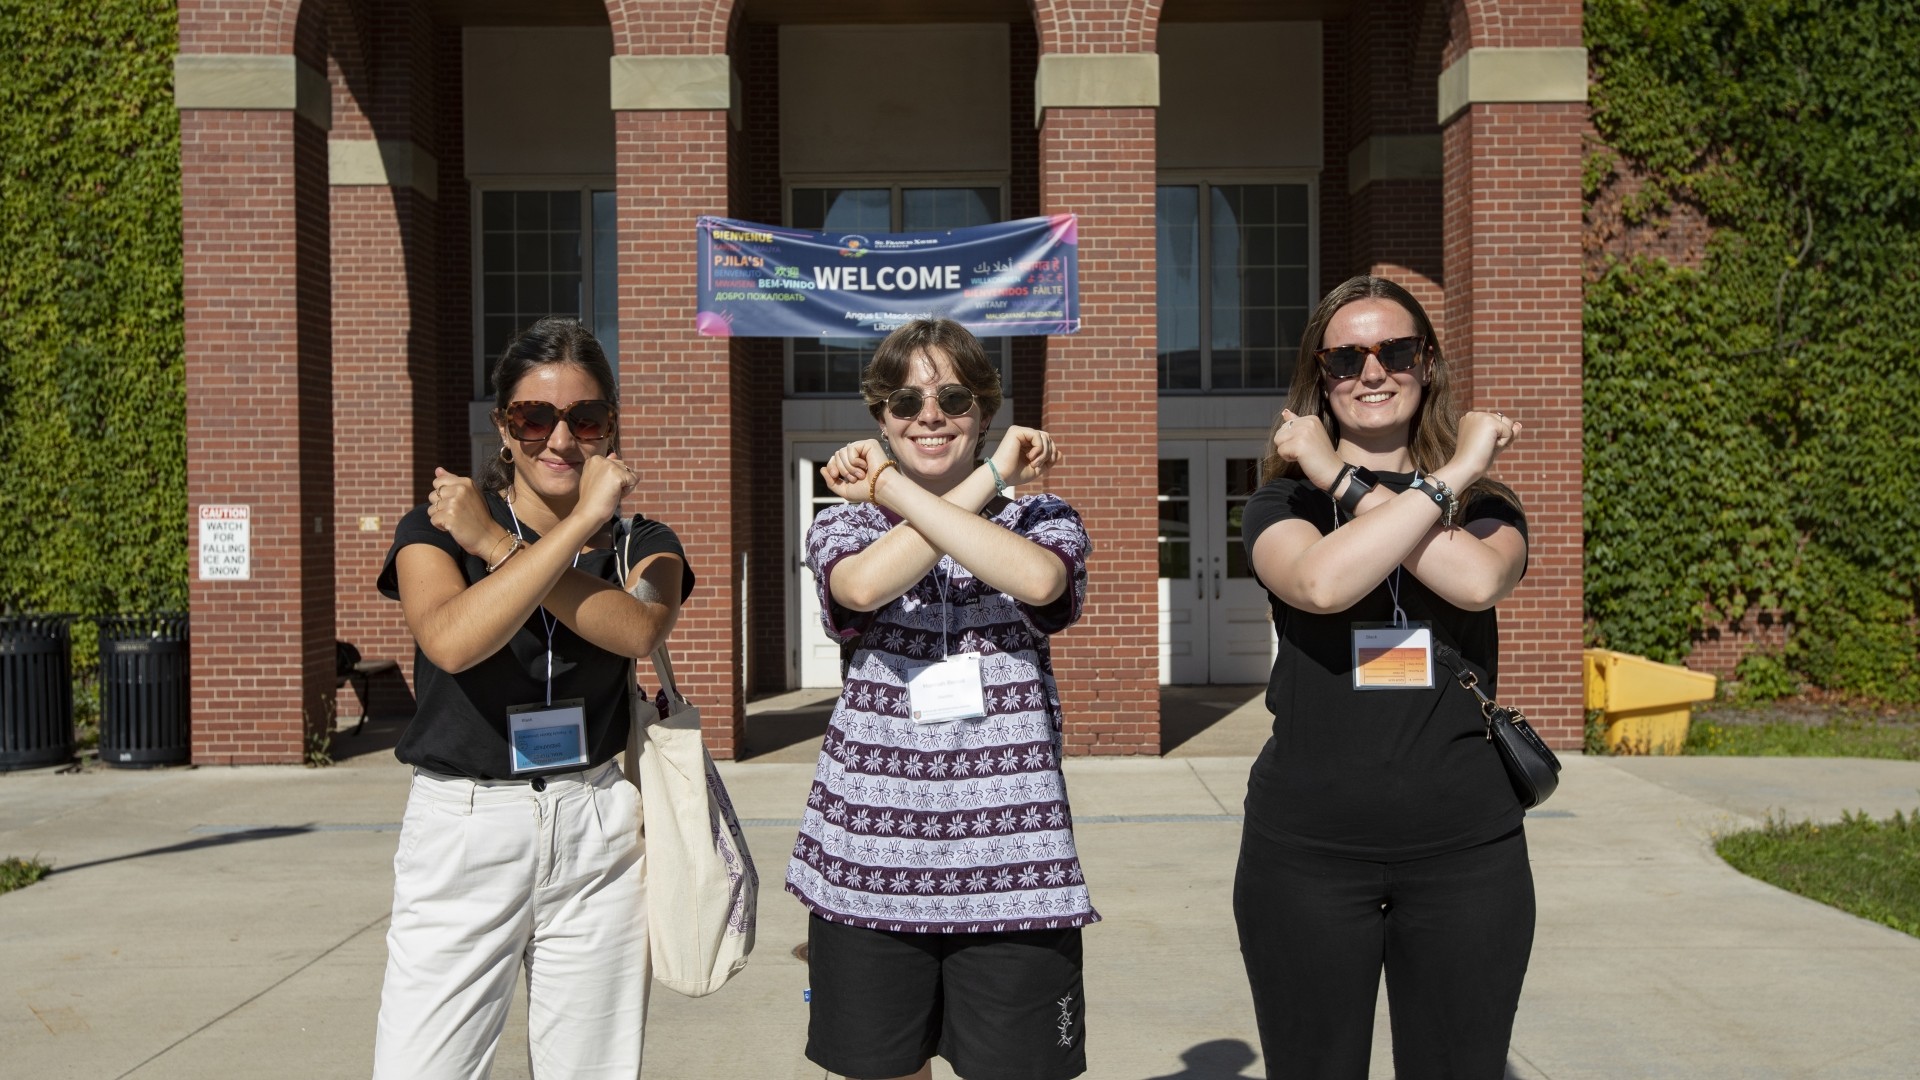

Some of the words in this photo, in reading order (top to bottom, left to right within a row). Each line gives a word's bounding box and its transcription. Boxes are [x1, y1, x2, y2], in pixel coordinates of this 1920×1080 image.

[713, 230, 773, 243] BIENVENUE
[714, 256, 764, 267] PJILA'SI
[713, 269, 762, 277] BENVENUTO
[814, 265, 961, 291] WELCOME
[758, 279, 815, 290] BEM-VINDO
[715, 292, 745, 302] ДОБРО
[747, 292, 805, 301] ПОЖАЛОВАТЬ
[974, 300, 1008, 309] WITAMY
[845, 311, 874, 321] Angus
[201, 508, 247, 519] CAUTION
[207, 522, 242, 530] WATCH
[213, 533, 234, 542] FOR
[203, 544, 245, 553] FALLING
[203, 555, 219, 564] ICE
[223, 555, 245, 564] AND
[209, 566, 239, 575] SNOW
